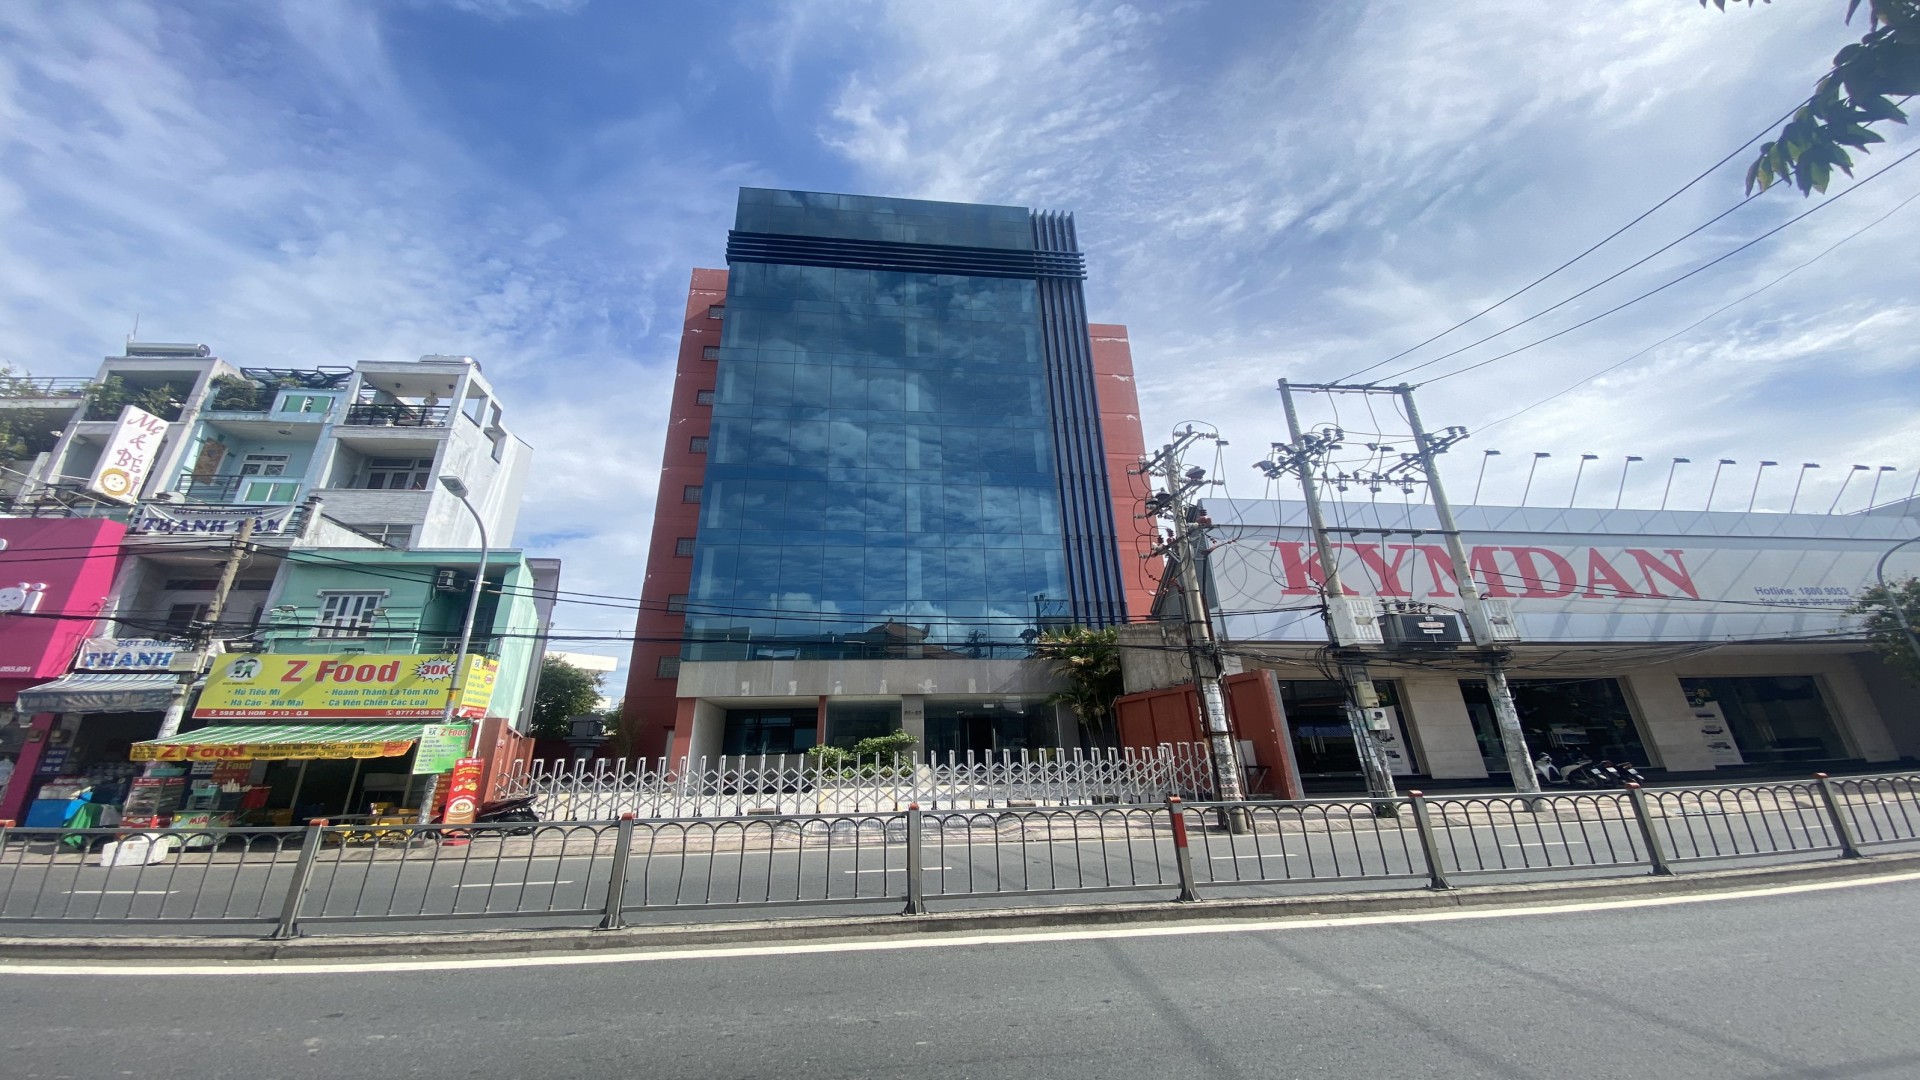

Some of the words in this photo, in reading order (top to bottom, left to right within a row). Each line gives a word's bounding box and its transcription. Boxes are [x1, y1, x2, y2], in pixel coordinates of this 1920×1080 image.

[143, 517, 228, 533] THANH
[1269, 541, 1701, 600] KYMDAN
[1754, 586, 1797, 596] Hotline:
[1798, 587, 1823, 596] 1800
[85, 652, 175, 667] THANH
[281, 660, 308, 682] Z
[314, 660, 401, 683] Food
[421, 664, 450, 676] 30K
[161, 744, 181, 758] Z
[185, 744, 246, 758] Food
